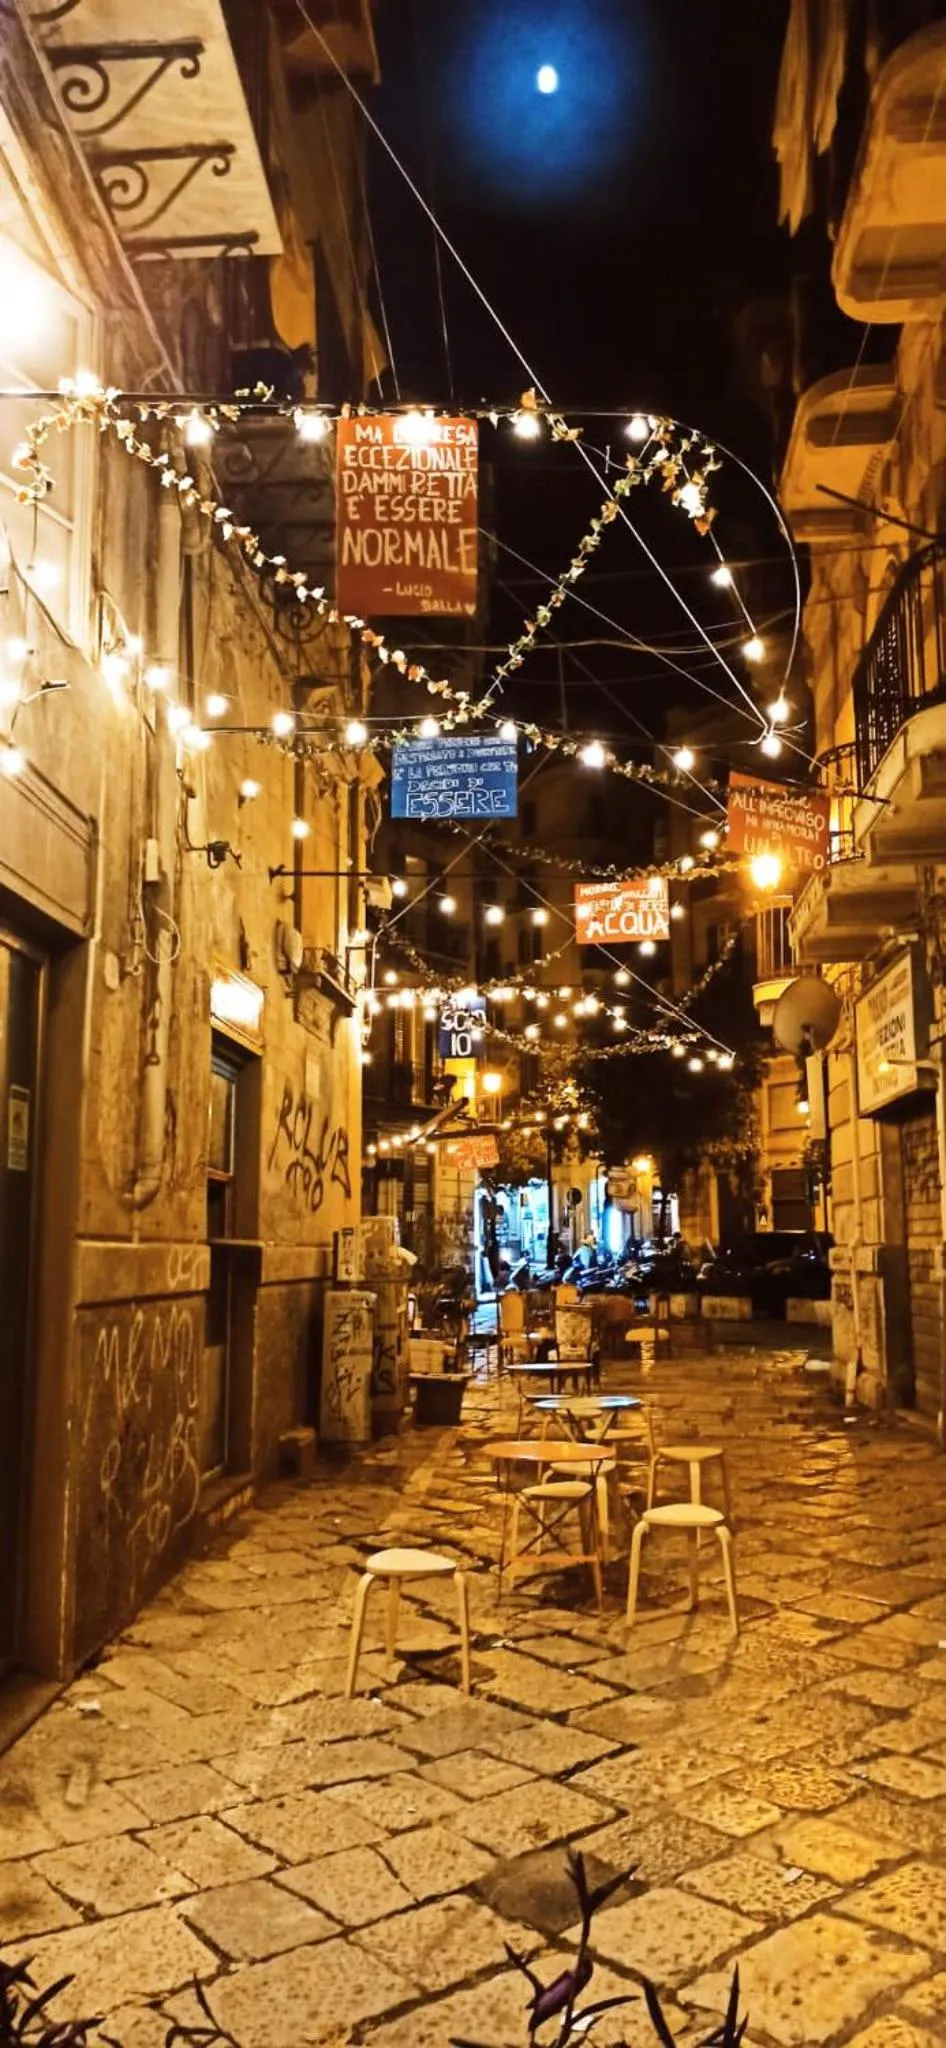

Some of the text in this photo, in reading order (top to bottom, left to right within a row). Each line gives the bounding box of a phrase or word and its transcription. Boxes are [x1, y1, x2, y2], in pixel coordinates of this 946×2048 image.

[355, 424, 383, 444] MA
[343, 445, 478, 471] ECCEZIONALE
[342, 470, 478, 499] DAMMI RETTA
[374, 495, 464, 524] ESSERE
[341, 527, 478, 576] NORMALE
[406, 788, 510, 818] ESSERE
[584, 909, 670, 939] ACQUA
